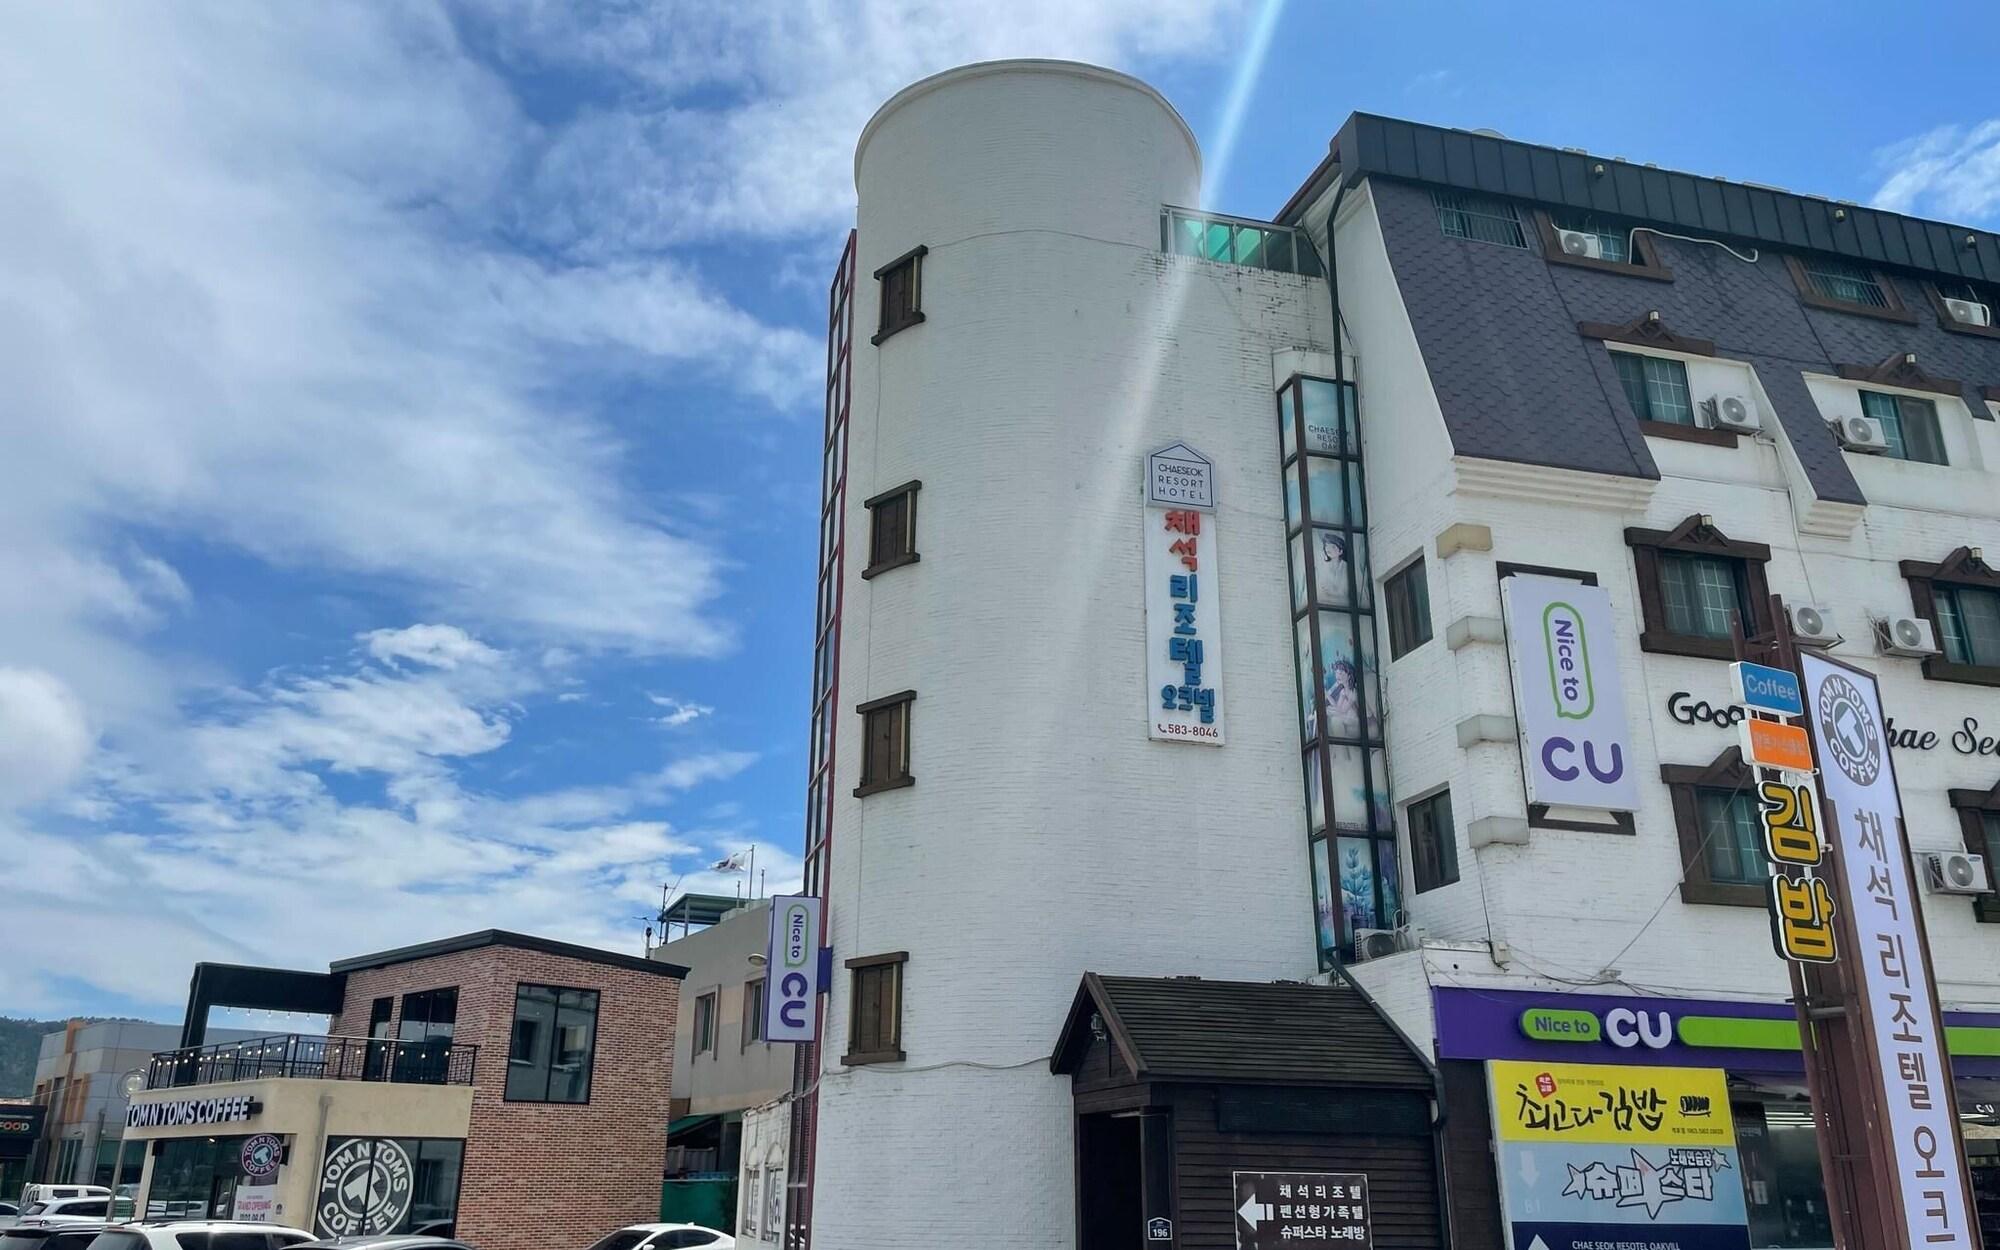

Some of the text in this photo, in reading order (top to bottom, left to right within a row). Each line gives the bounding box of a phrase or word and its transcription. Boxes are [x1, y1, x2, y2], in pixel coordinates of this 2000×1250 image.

[1158, 463, 1204, 477] CHAESEOK
[1158, 475, 1205, 488] RESORT
[1158, 487, 1205, 500] HOTEL
[1554, 619, 1580, 701] Nice to
[1745, 674, 1797, 700] Coffee
[1843, 681, 1877, 740] TOMS
[1167, 723, 1219, 738] 583-8046
[1886, 717, 1940, 750] hae
[1541, 736, 1624, 784] CU
[1830, 738, 1879, 783] COFFEE
[1761, 782, 1837, 961] 김밥
[791, 914, 804, 959] Nice to
[780, 972, 808, 1028] CU
[1534, 1007, 1673, 1049] Nice to CU
[126, 1096, 251, 1128] TOM N TOMS COFFEE
[1975, 1103, 1995, 1114] CU
[245, 1139, 259, 1157] TOM
[266, 1136, 281, 1157] TOMS
[245, 1159, 278, 1174] COFFEE
[322, 1142, 408, 1193] TOM N TOMS
[323, 1201, 400, 1236] COFFEE
[1153, 1228, 1168, 1238] 196
[1280, 1225, 1365, 1240] 슈퍼스타 노래방
[1571, 1240, 1594, 1250] CHAE
